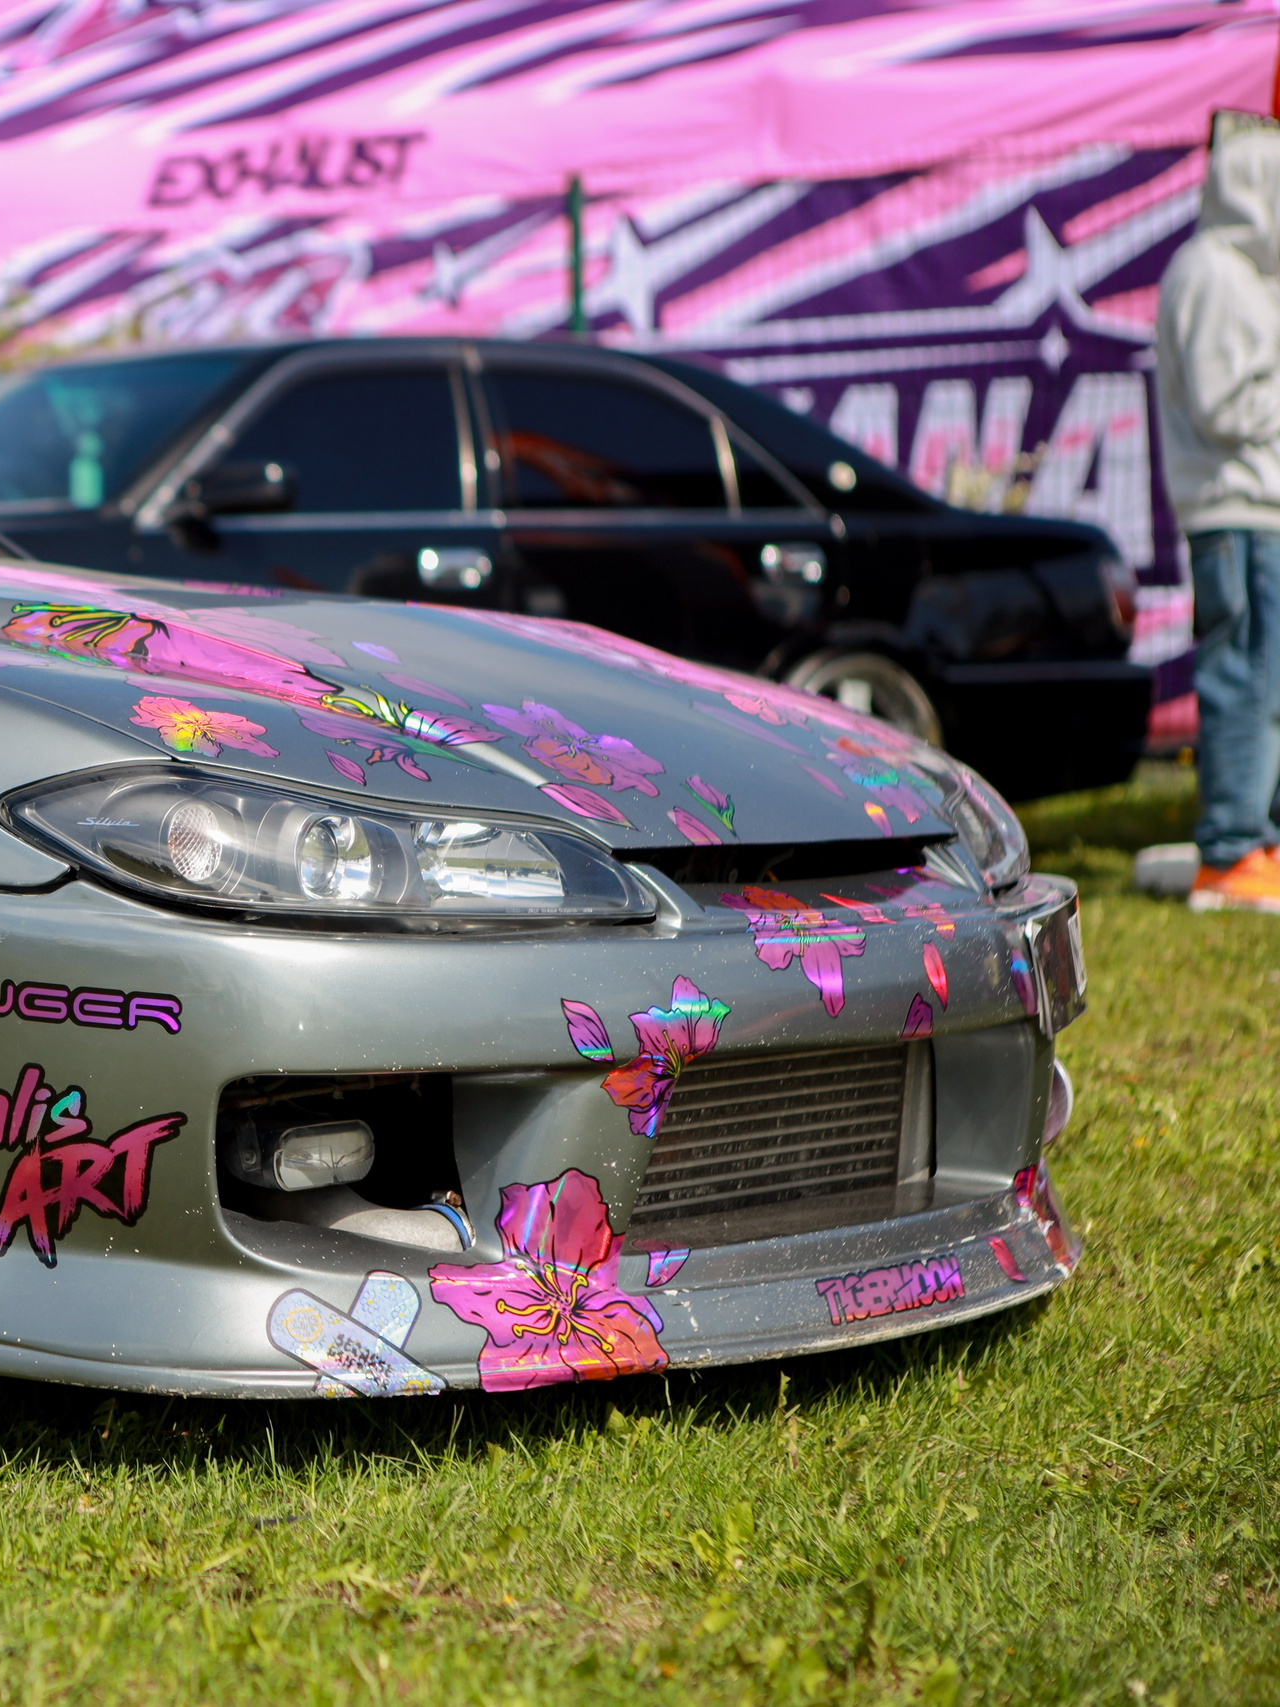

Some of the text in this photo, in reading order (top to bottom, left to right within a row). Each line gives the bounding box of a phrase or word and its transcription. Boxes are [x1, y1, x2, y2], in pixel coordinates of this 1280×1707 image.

[145, 132, 428, 208] EXHAUST
[77, 816, 140, 827] Silvia
[815, 1253, 965, 1326] TIGERMOON
